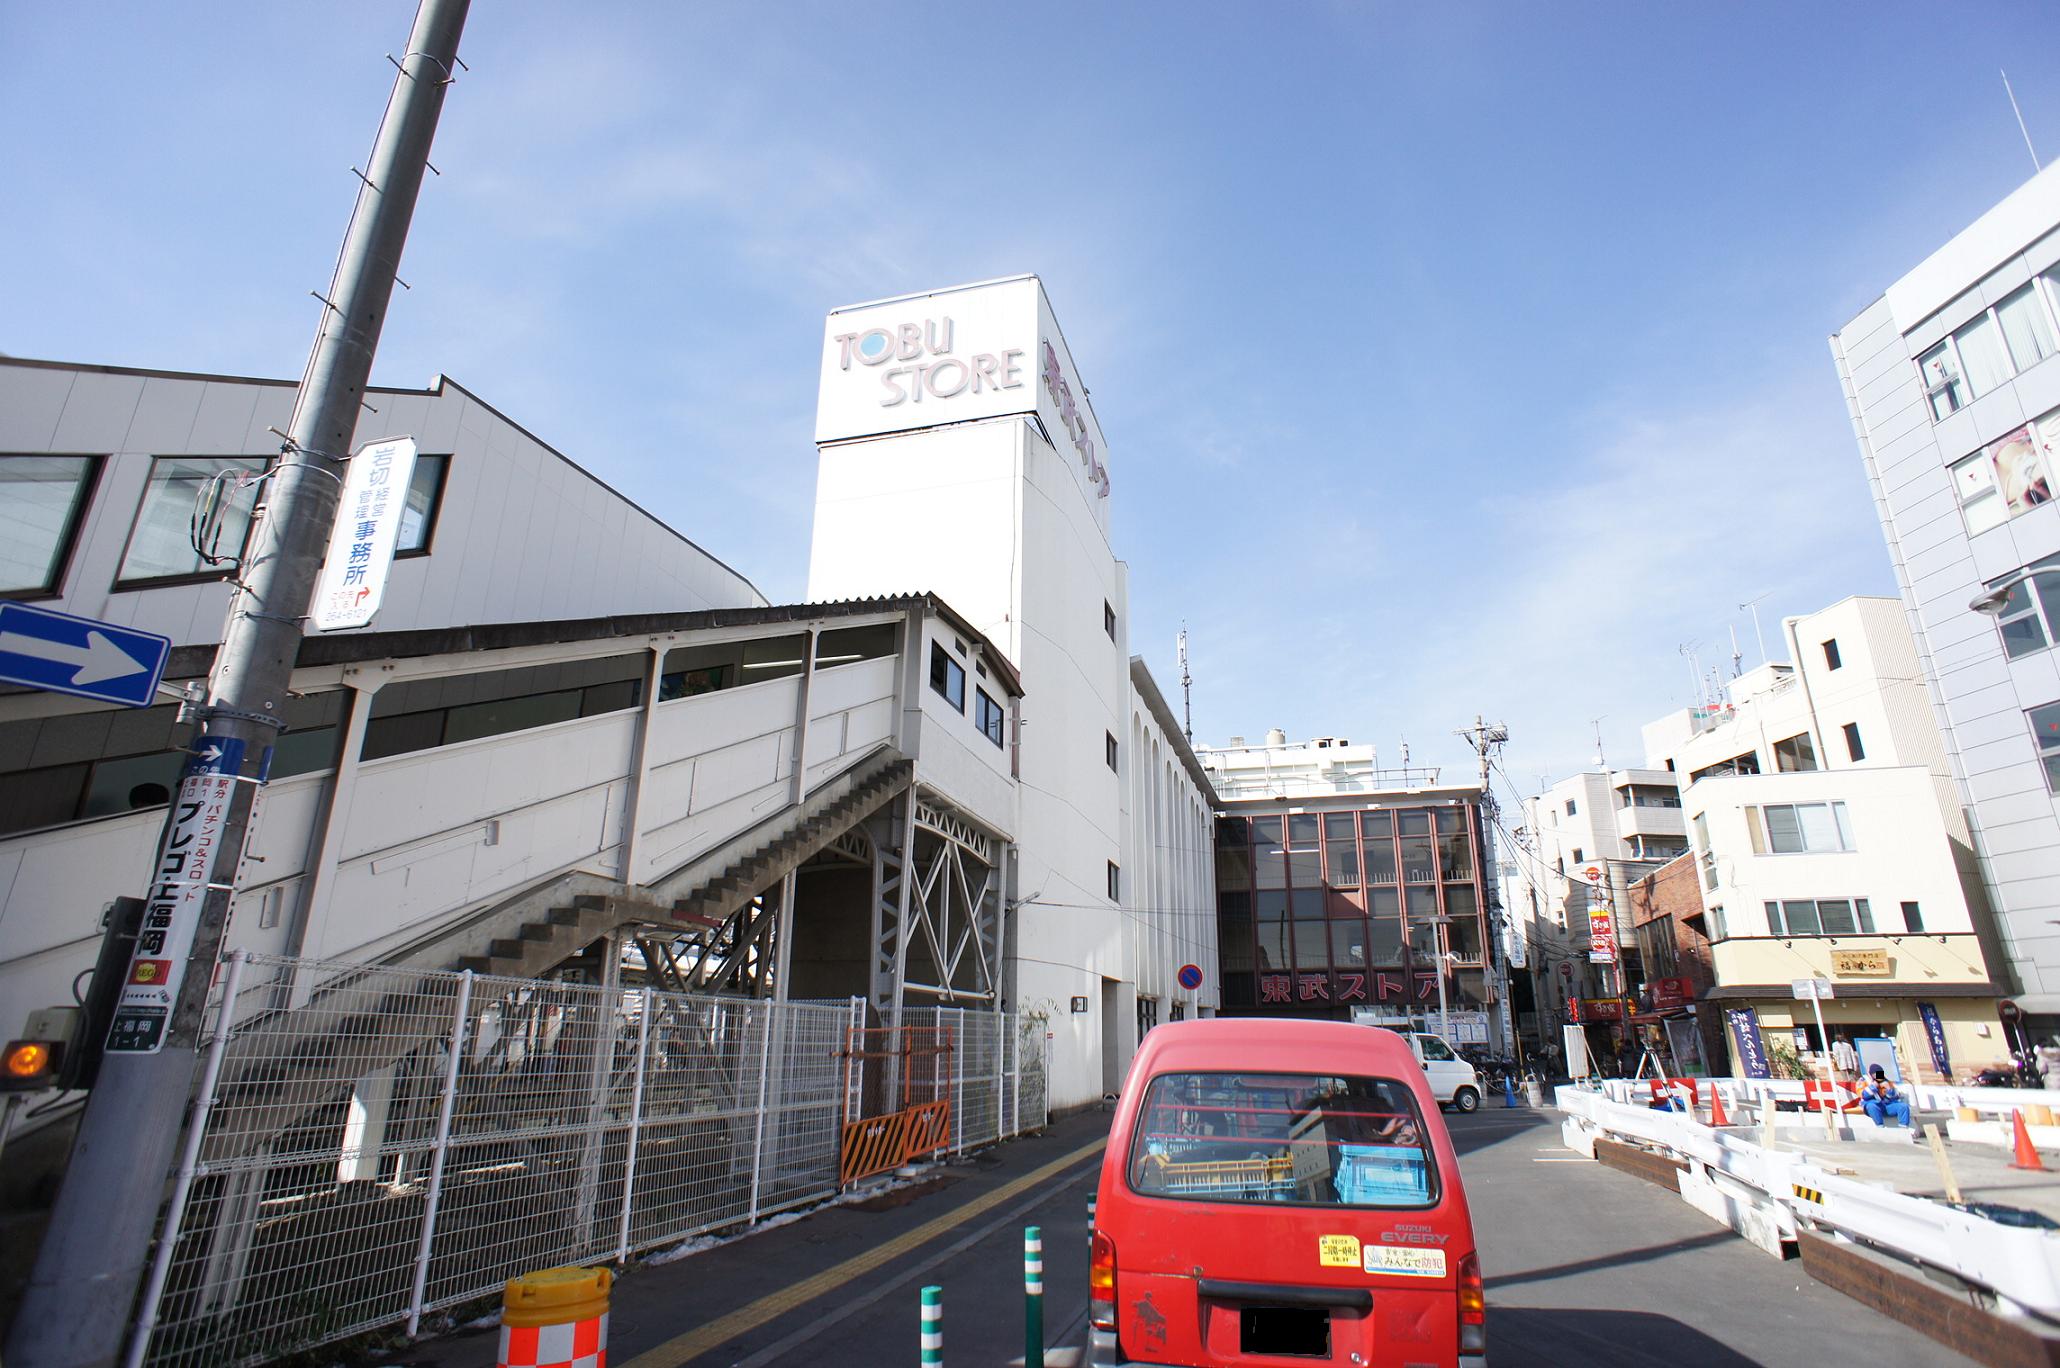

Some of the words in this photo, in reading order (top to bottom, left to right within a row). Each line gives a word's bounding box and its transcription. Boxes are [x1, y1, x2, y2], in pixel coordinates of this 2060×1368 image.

[834, 316, 954, 371] TOBU
[880, 348, 1025, 407] STORE
[343, 520, 378, 586] 事務所
[1261, 972, 1440, 1003] 東武ストア
[1380, 1231, 1450, 1245] EVERY
